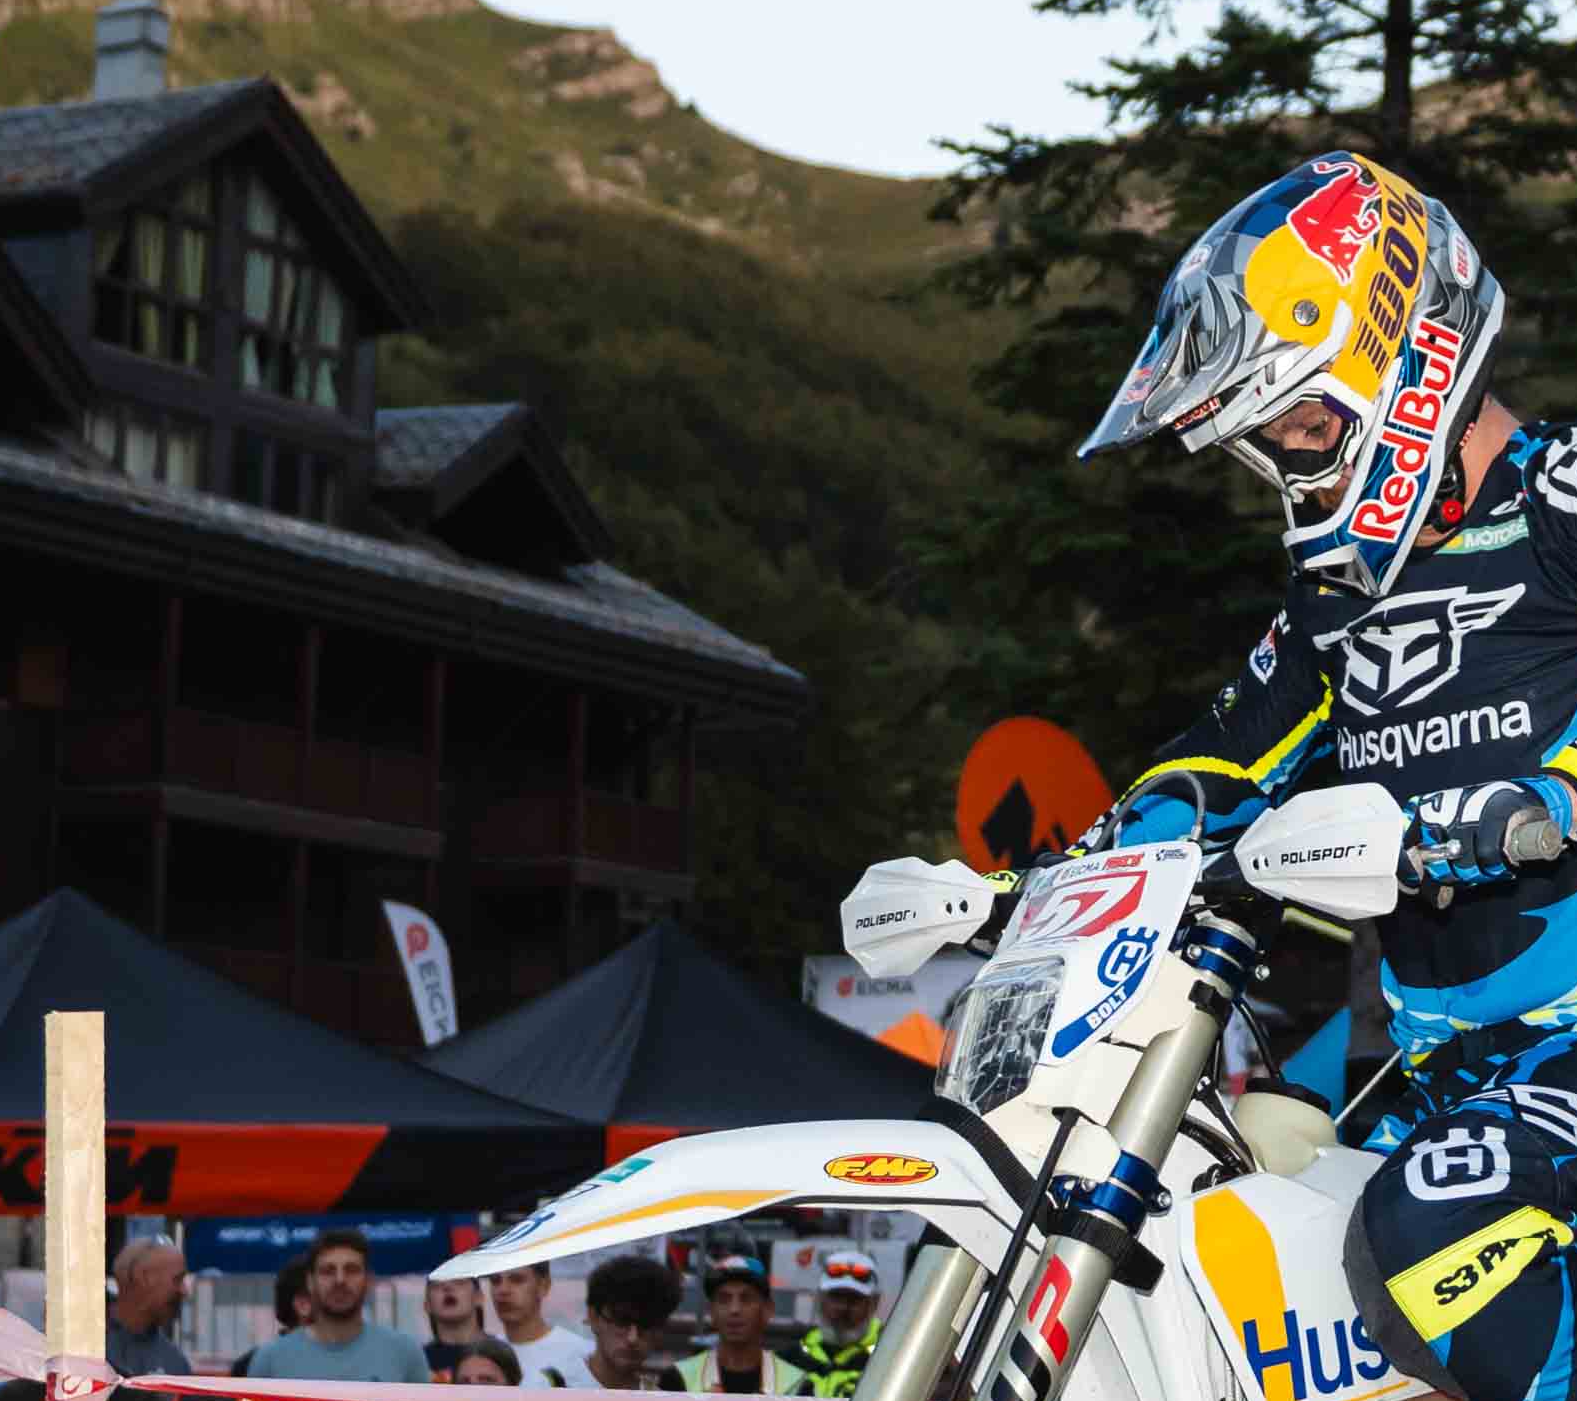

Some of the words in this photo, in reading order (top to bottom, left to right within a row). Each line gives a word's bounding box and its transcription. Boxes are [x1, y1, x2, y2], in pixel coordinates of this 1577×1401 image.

[1355, 183, 1426, 378] 100%
[1336, 699, 1534, 772] Husqvarna
[1280, 843, 1368, 865] POLISPORT
[1085, 988, 1128, 1031] BOLT
[829, 1155, 935, 1180] FMF
